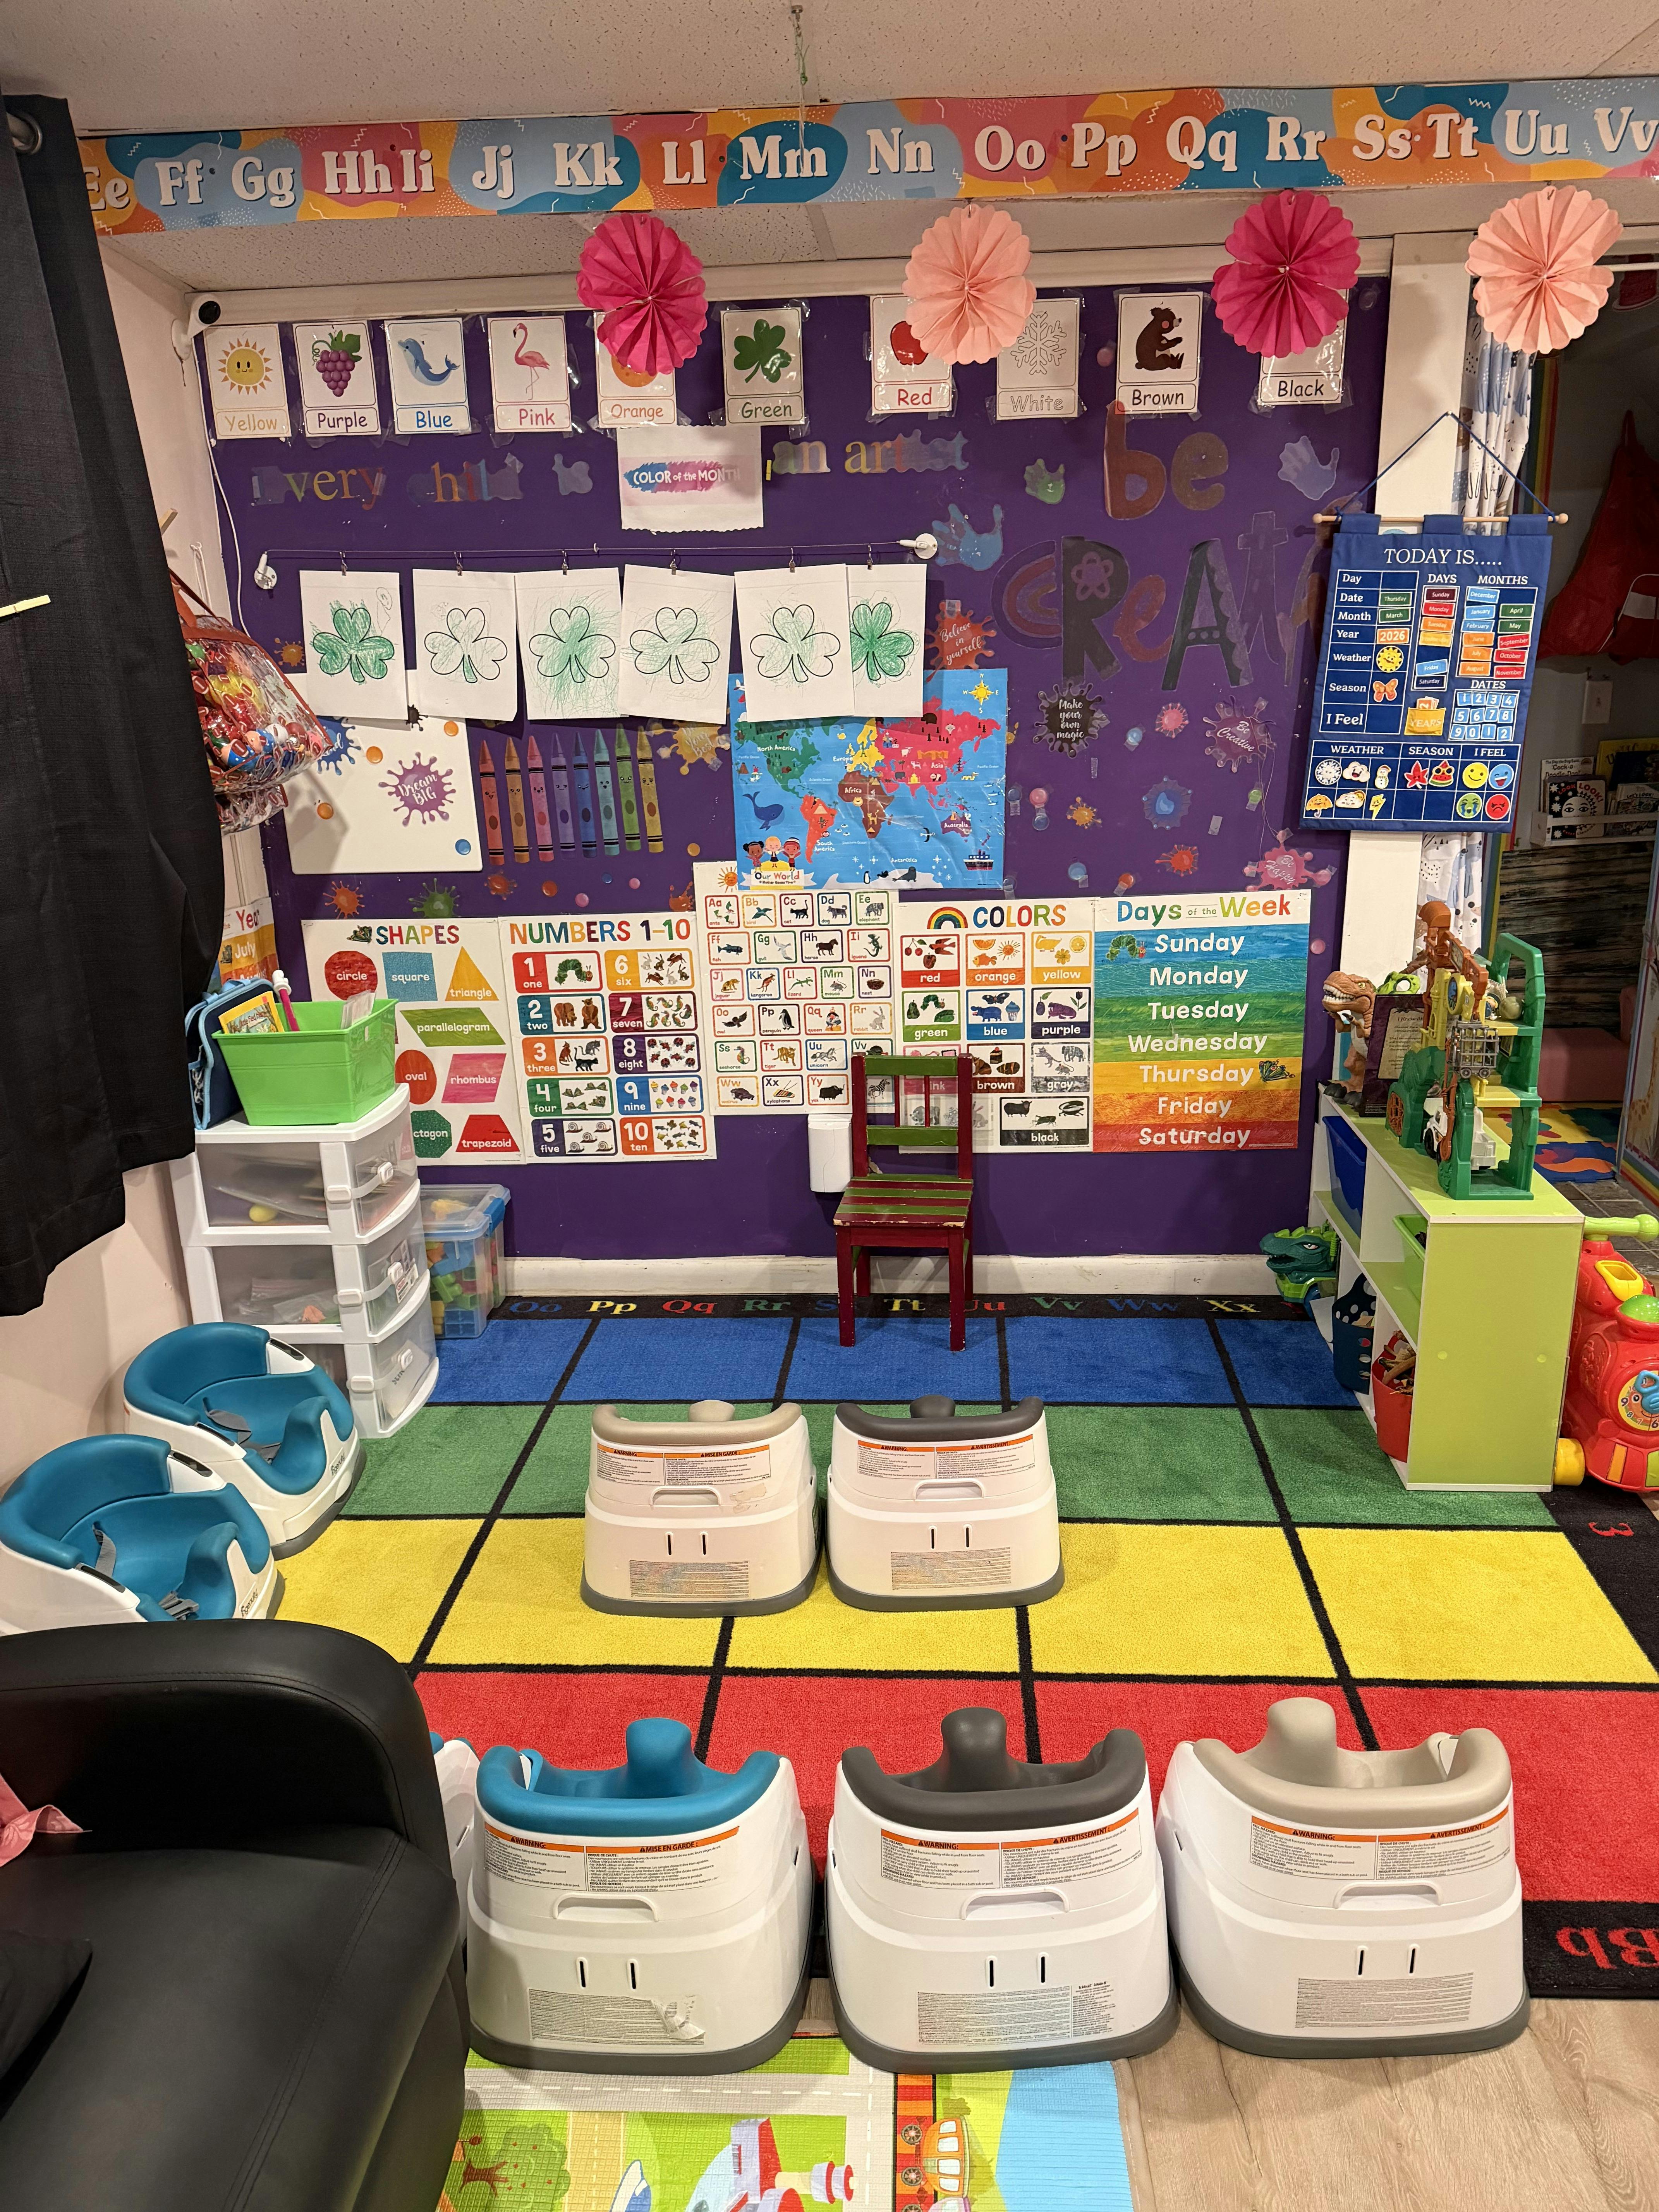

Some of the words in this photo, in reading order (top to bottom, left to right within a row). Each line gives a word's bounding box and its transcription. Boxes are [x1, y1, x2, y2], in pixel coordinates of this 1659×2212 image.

[156, 161, 204, 205] Ff
[233, 157, 294, 207] Gg
[322, 150, 393, 194] Hh
[400, 149, 434, 192] Ii
[472, 145, 515, 199] Jj
[553, 142, 623, 187] Kk
[662, 140, 708, 185] Ll
[739, 136, 828, 180] Mm
[867, 127, 934, 174] Nn
[975, 125, 1046, 171] Oo
[1071, 121, 1137, 176] Pp
[1166, 115, 1238, 172] Qq
[1266, 116, 1326, 161] Rr
[1352, 114, 1412, 160] Ss
[1427, 112, 1479, 159] Tt
[1505, 109, 1569, 156] Uu
[1595, 106, 1659, 153] Vv
[1278, 379, 1324, 398] Black
[898, 387, 932, 406] Red
[1132, 389, 1184, 406] Brown
[741, 402, 792, 417] Green
[1010, 395, 1063, 413] White
[611, 404, 664, 419] Orange
[318, 412, 368, 433] Purple
[416, 411, 453, 428] Blue
[519, 409, 555, 426] Pink
[225, 416, 278, 432] Yellow
[633, 471, 672, 484] COLOR
[673, 472, 682, 481] of
[684, 472, 697, 481] the
[699, 468, 741, 482] MONTH
[1384, 548, 1451, 564] TODAY
[1343, 574, 1361, 584] Day
[1428, 574, 1457, 583] DAYS
[1478, 575, 1528, 584] MONTHS
[1340, 593, 1363, 603] Date
[1338, 611, 1371, 621] Month
[939, 623, 970, 642] Believe
[1337, 630, 1359, 639] Year
[1380, 631, 1405, 641] 2026
[956, 638, 964, 646] in
[1500, 637, 1529, 646] September
[946, 636, 982, 665] yourself
[1333, 653, 1372, 662] Weather
[1329, 683, 1366, 692] Season
[1471, 680, 1506, 690] DATES
[1059, 699, 1083, 709] Make
[1060, 711, 1082, 723] your
[1326, 714, 1331, 724] I
[1335, 714, 1363, 726] Feel
[1237, 721, 1250, 733] Be
[1057, 729, 1084, 742] magic
[1217, 727, 1254, 751] Creative
[1331, 746, 1384, 754] WEATHER
[1409, 746, 1454, 755] SEASON
[1480, 748, 1506, 757] FEEL
[398, 774, 438, 797] Dream
[412, 787, 437, 805] BIG
[774, 871, 799, 879] World
[1117, 901, 1182, 927] Days
[1220, 894, 1291, 918] Week
[973, 905, 1066, 928] COLORS
[376, 925, 459, 945] SHAPES
[510, 920, 630, 944] NUMBERS
[1155, 933, 1245, 956] Sunday
[337, 972, 367, 981] circle
[392, 973, 430, 984] square
[920, 973, 940, 982] red
[975, 973, 1016, 984] orange
[1043, 970, 1081, 981] yellow
[1150, 965, 1248, 989] Monday
[450, 988, 492, 1000] triangle
[1147, 1001, 1249, 1022] Tuesday
[417, 1023, 489, 1034] parallelogram
[915, 1028, 948, 1040] green
[984, 1027, 1007, 1036] blue
[1042, 1025, 1080, 1036] purple
[1128, 1032, 1267, 1054] Wednesday
[527, 1063, 556, 1072] three
[619, 1060, 643, 1070] eight
[405, 1072, 427, 1080] oval
[451, 1075, 496, 1084] rhombus
[1139, 1063, 1254, 1087] Thursday
[977, 1081, 1015, 1089] brown
[1047, 1080, 1073, 1091] gray
[534, 1104, 556, 1113] four
[1158, 1096, 1232, 1118] Friday
[1031, 1133, 1059, 1142] black
[1138, 1127, 1250, 1149] Saturday
[462, 1139, 511, 1149] trapezoid
[540, 1144, 559, 1153] five
[586, 1300, 637, 1315] Pp
[662, 1300, 718, 1314] Qq
[741, 1299, 791, 1311] Rr
[1204, 1300, 1261, 1312] Xx
[1299, 1831, 1335, 1840] WARNING:
[515, 1837, 546, 1849] WARNING:
[923, 1841, 959, 1850] WARNING:
